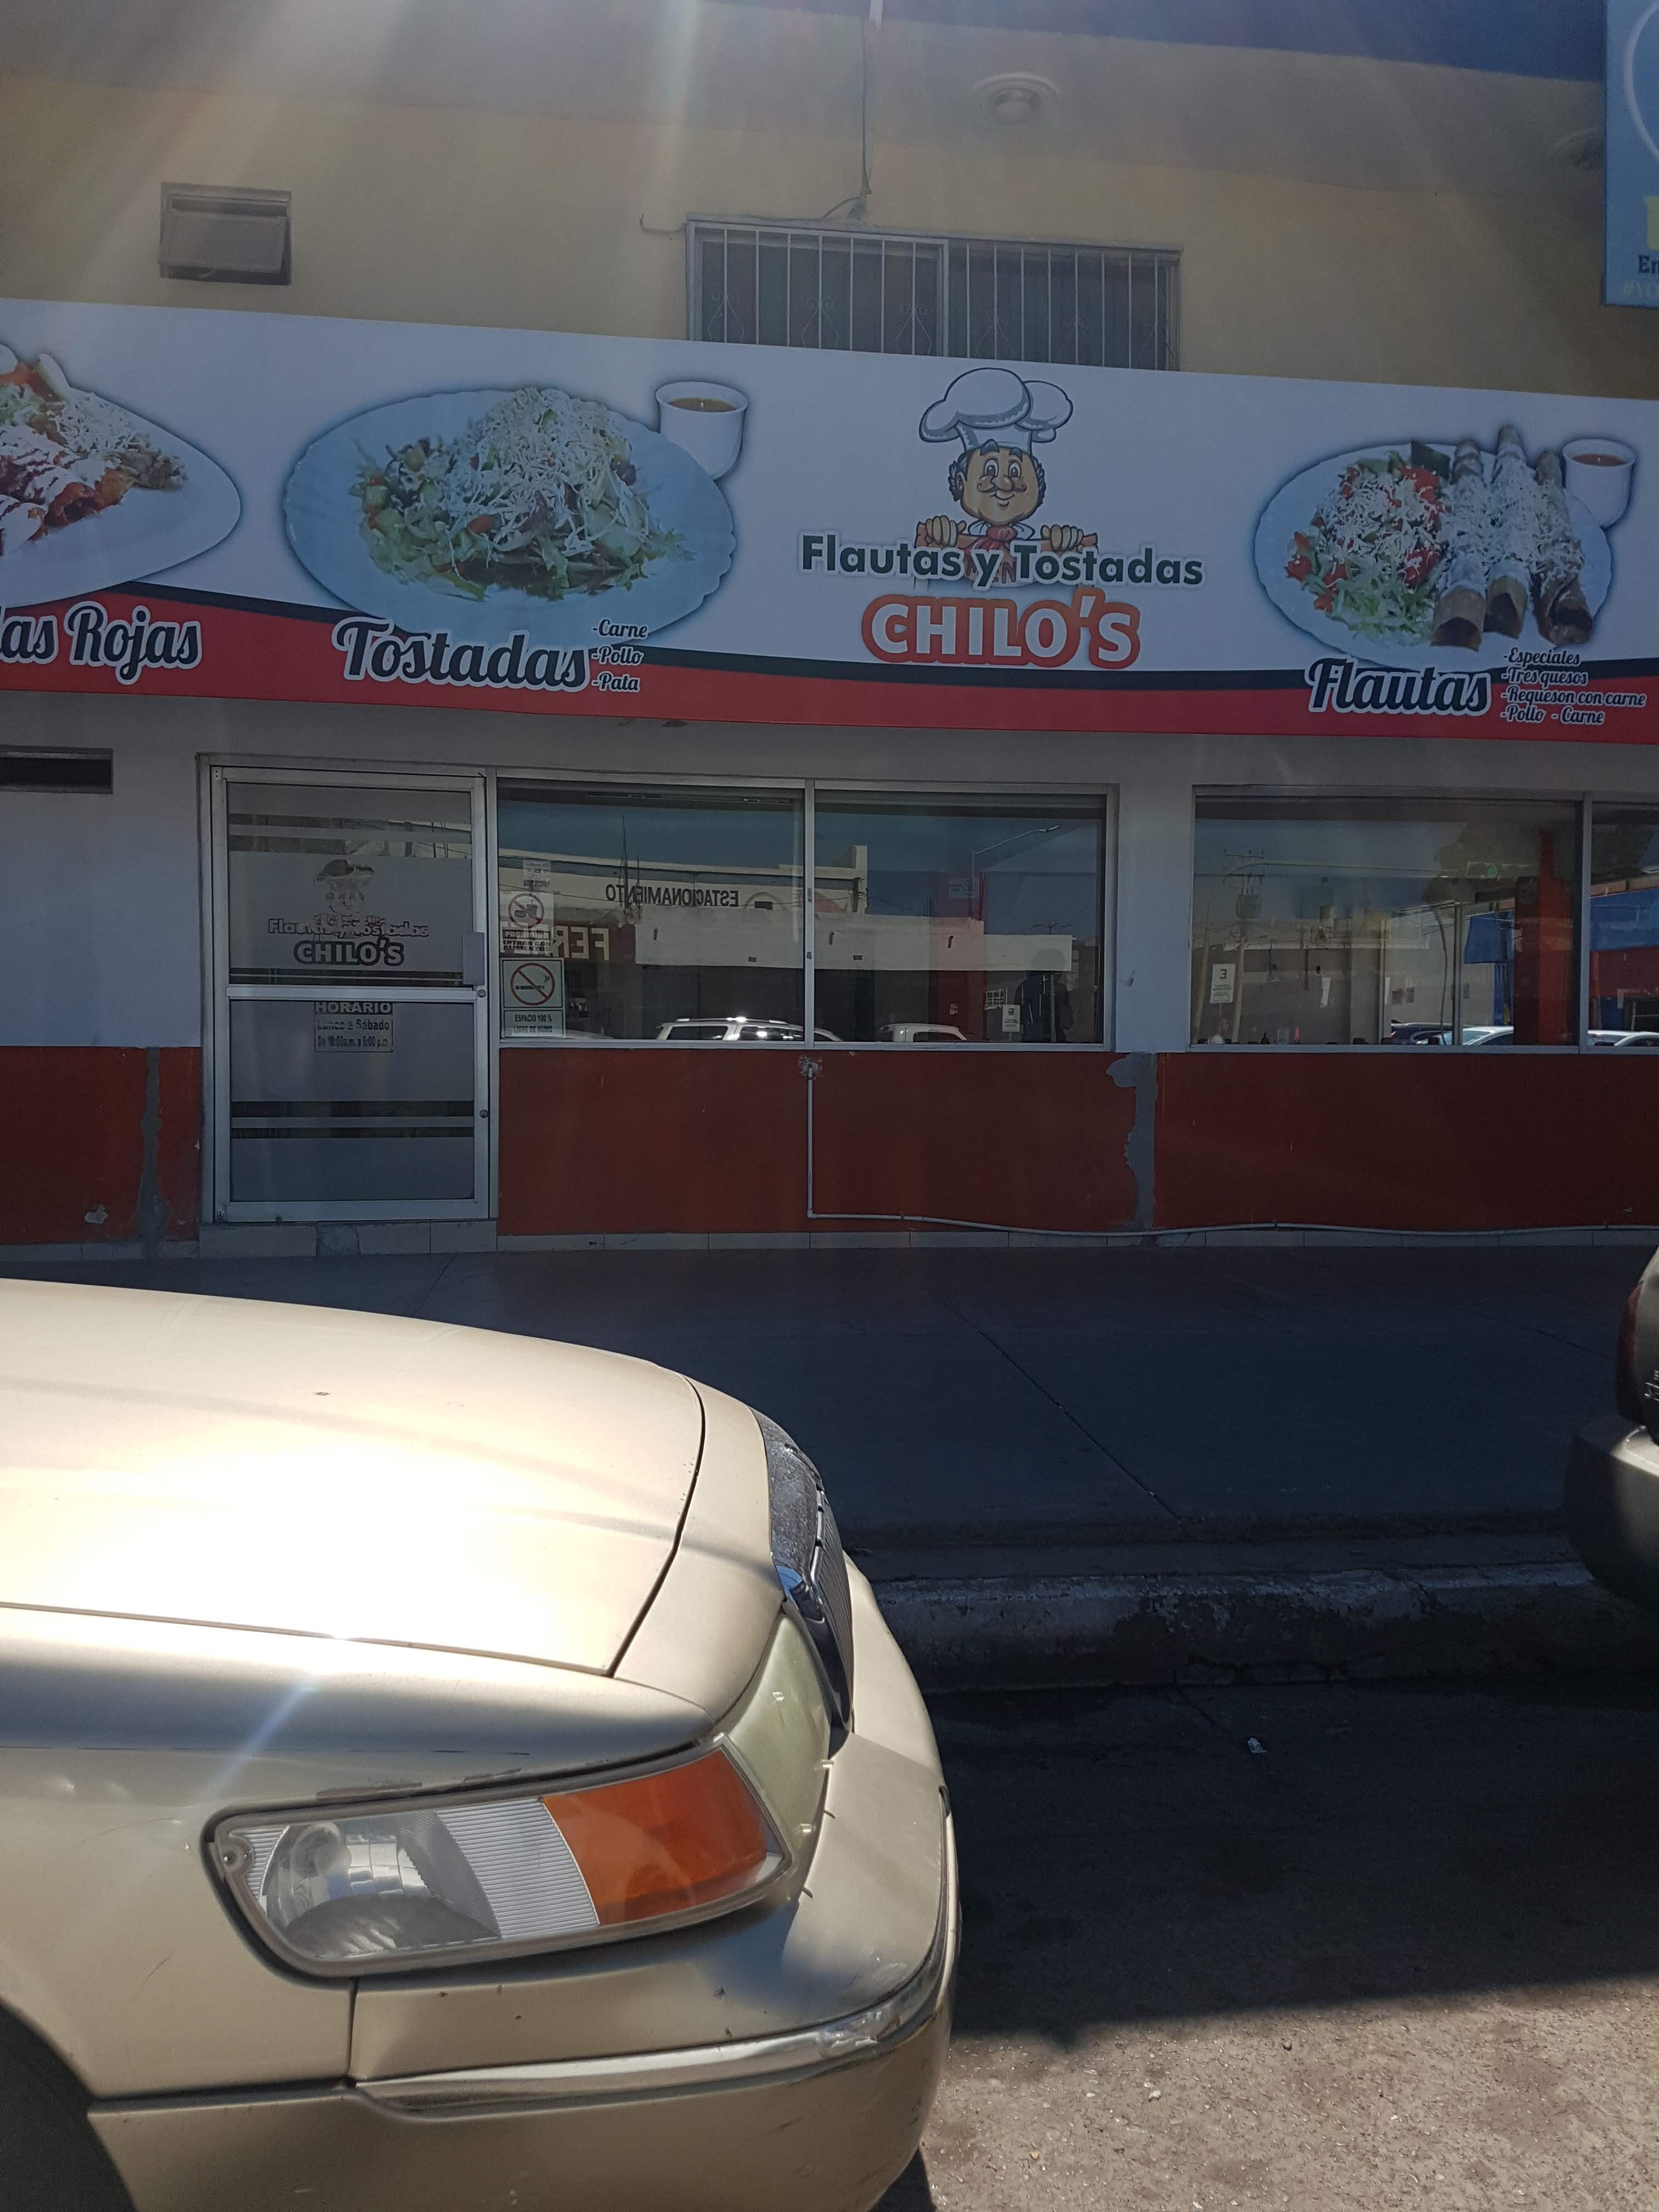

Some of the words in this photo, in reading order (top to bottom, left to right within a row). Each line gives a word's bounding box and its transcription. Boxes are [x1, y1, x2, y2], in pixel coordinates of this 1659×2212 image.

[802, 534, 962, 577] Flautas
[975, 552, 1002, 588] y
[1013, 544, 1204, 585] Tostadas
[0, 605, 55, 659] as
[67, 604, 199, 681] Rojas
[871, 594, 1132, 663] CHILO'S
[335, 619, 586, 689] Tostadas
[1308, 657, 1489, 713] Flautas
[1539, 672, 1588, 688] quesos
[1577, 691, 1602, 704] con
[1605, 692, 1646, 706] carne
[296, 938, 403, 964] CHILO'S
[315, 1002, 392, 1013] HORARIO
[515, 1014, 537, 1022] ESPACIO
[538, 1014, 547, 1022] 100
